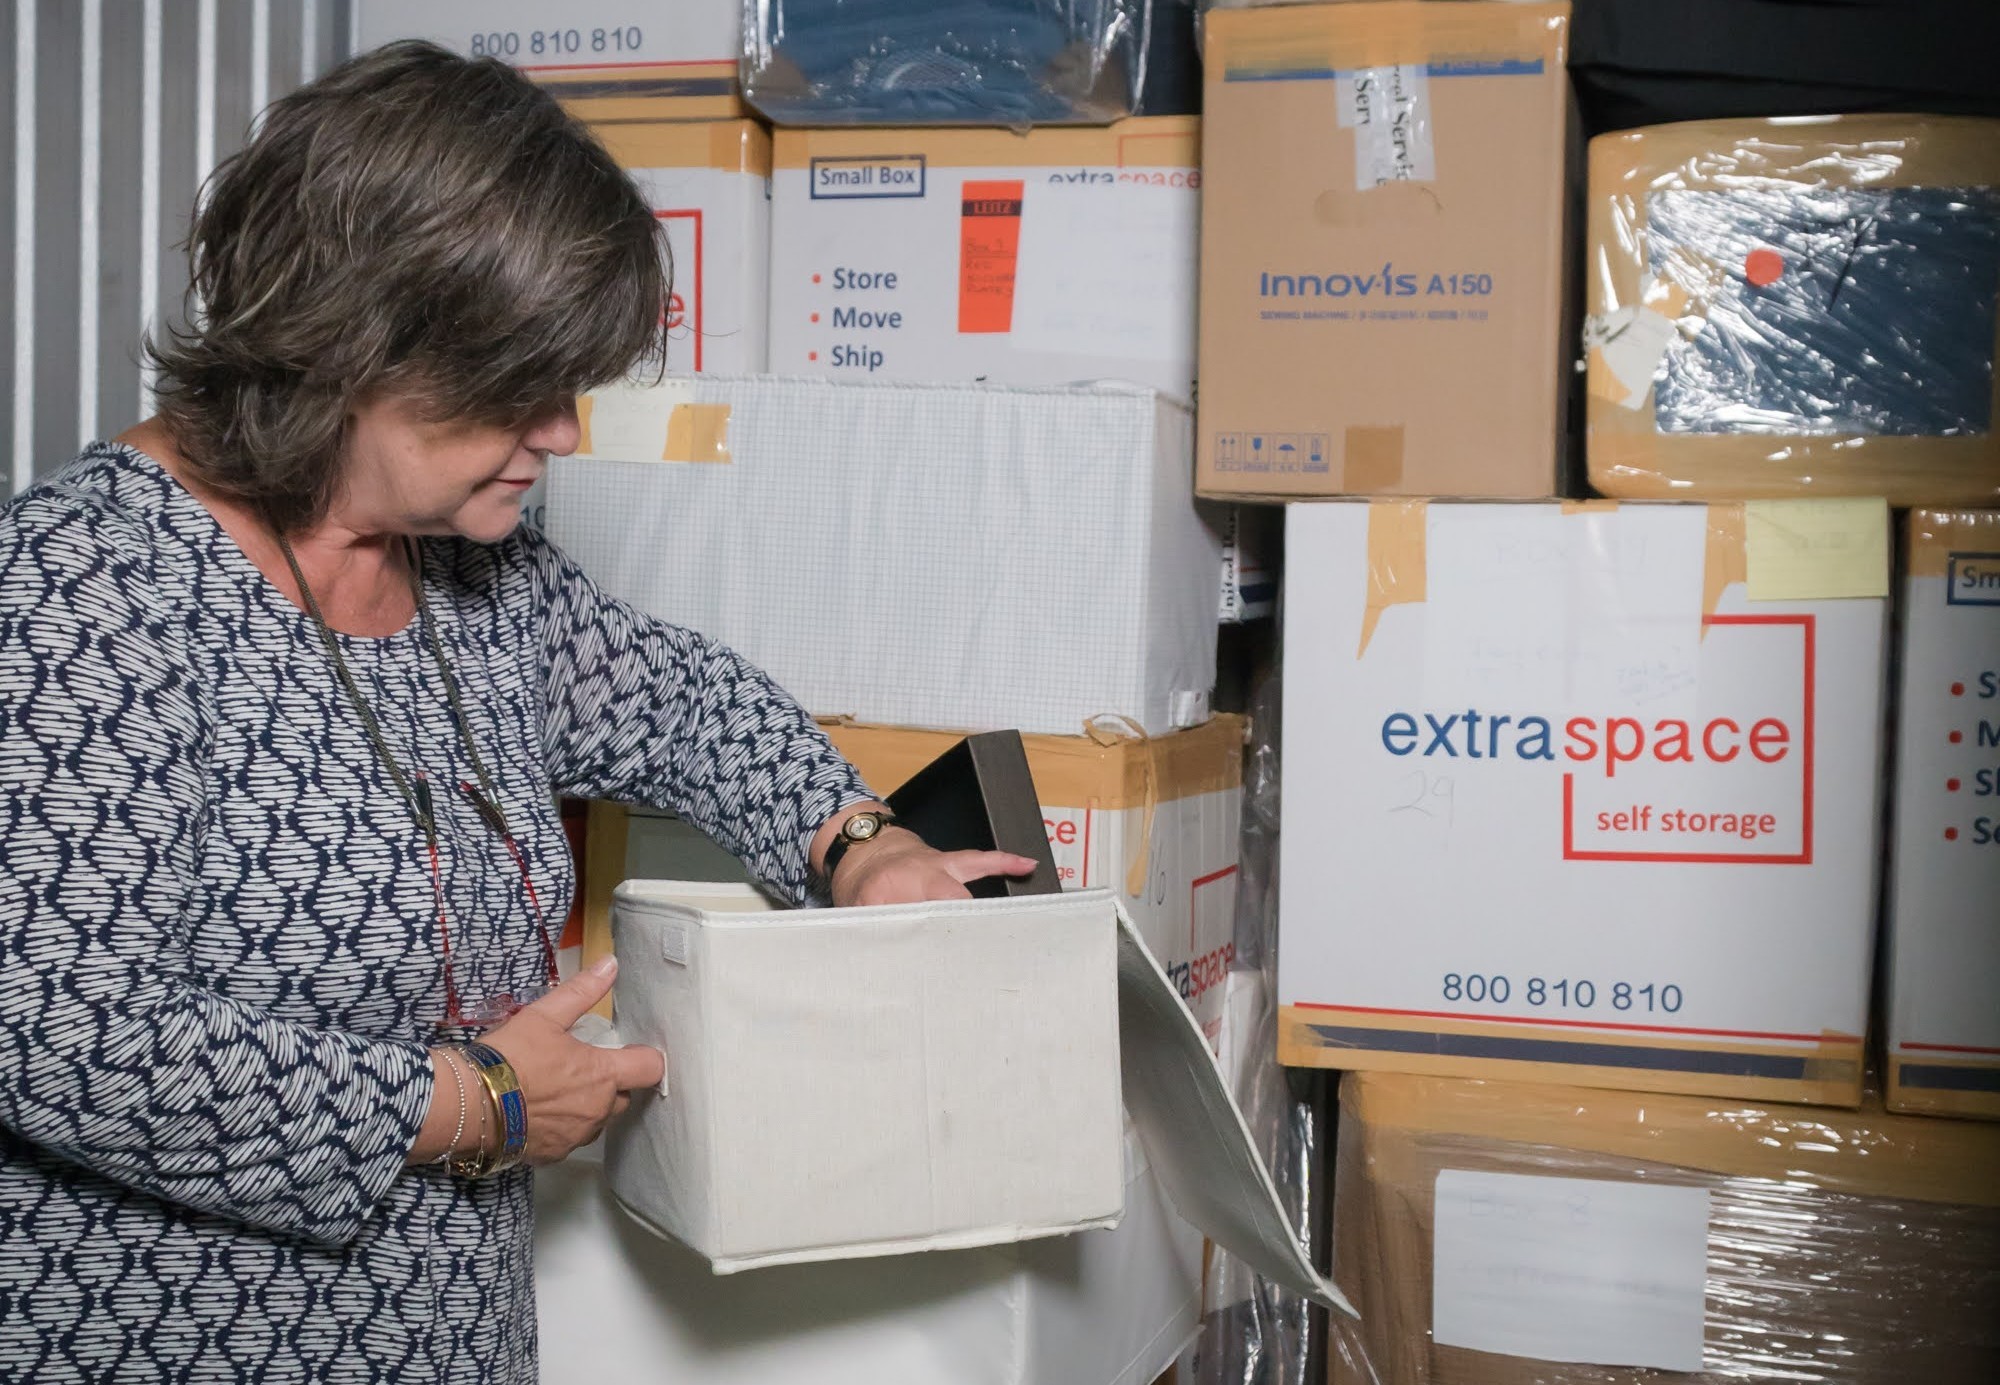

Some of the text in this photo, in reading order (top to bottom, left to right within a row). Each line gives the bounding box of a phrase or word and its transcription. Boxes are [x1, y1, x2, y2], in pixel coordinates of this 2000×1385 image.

[471, 26, 643, 57] 800 810 810
[819, 165, 916, 187] Small Box
[832, 267, 898, 291] Store
[1426, 273, 1493, 296] A150
[832, 307, 903, 329] Move
[831, 344, 884, 372] Ship
[1977, 670, 2000, 699] S
[1381, 708, 1791, 777] extraspace
[1597, 805, 1777, 840] self storage
[1442, 972, 1684, 1013] 800 810 810
